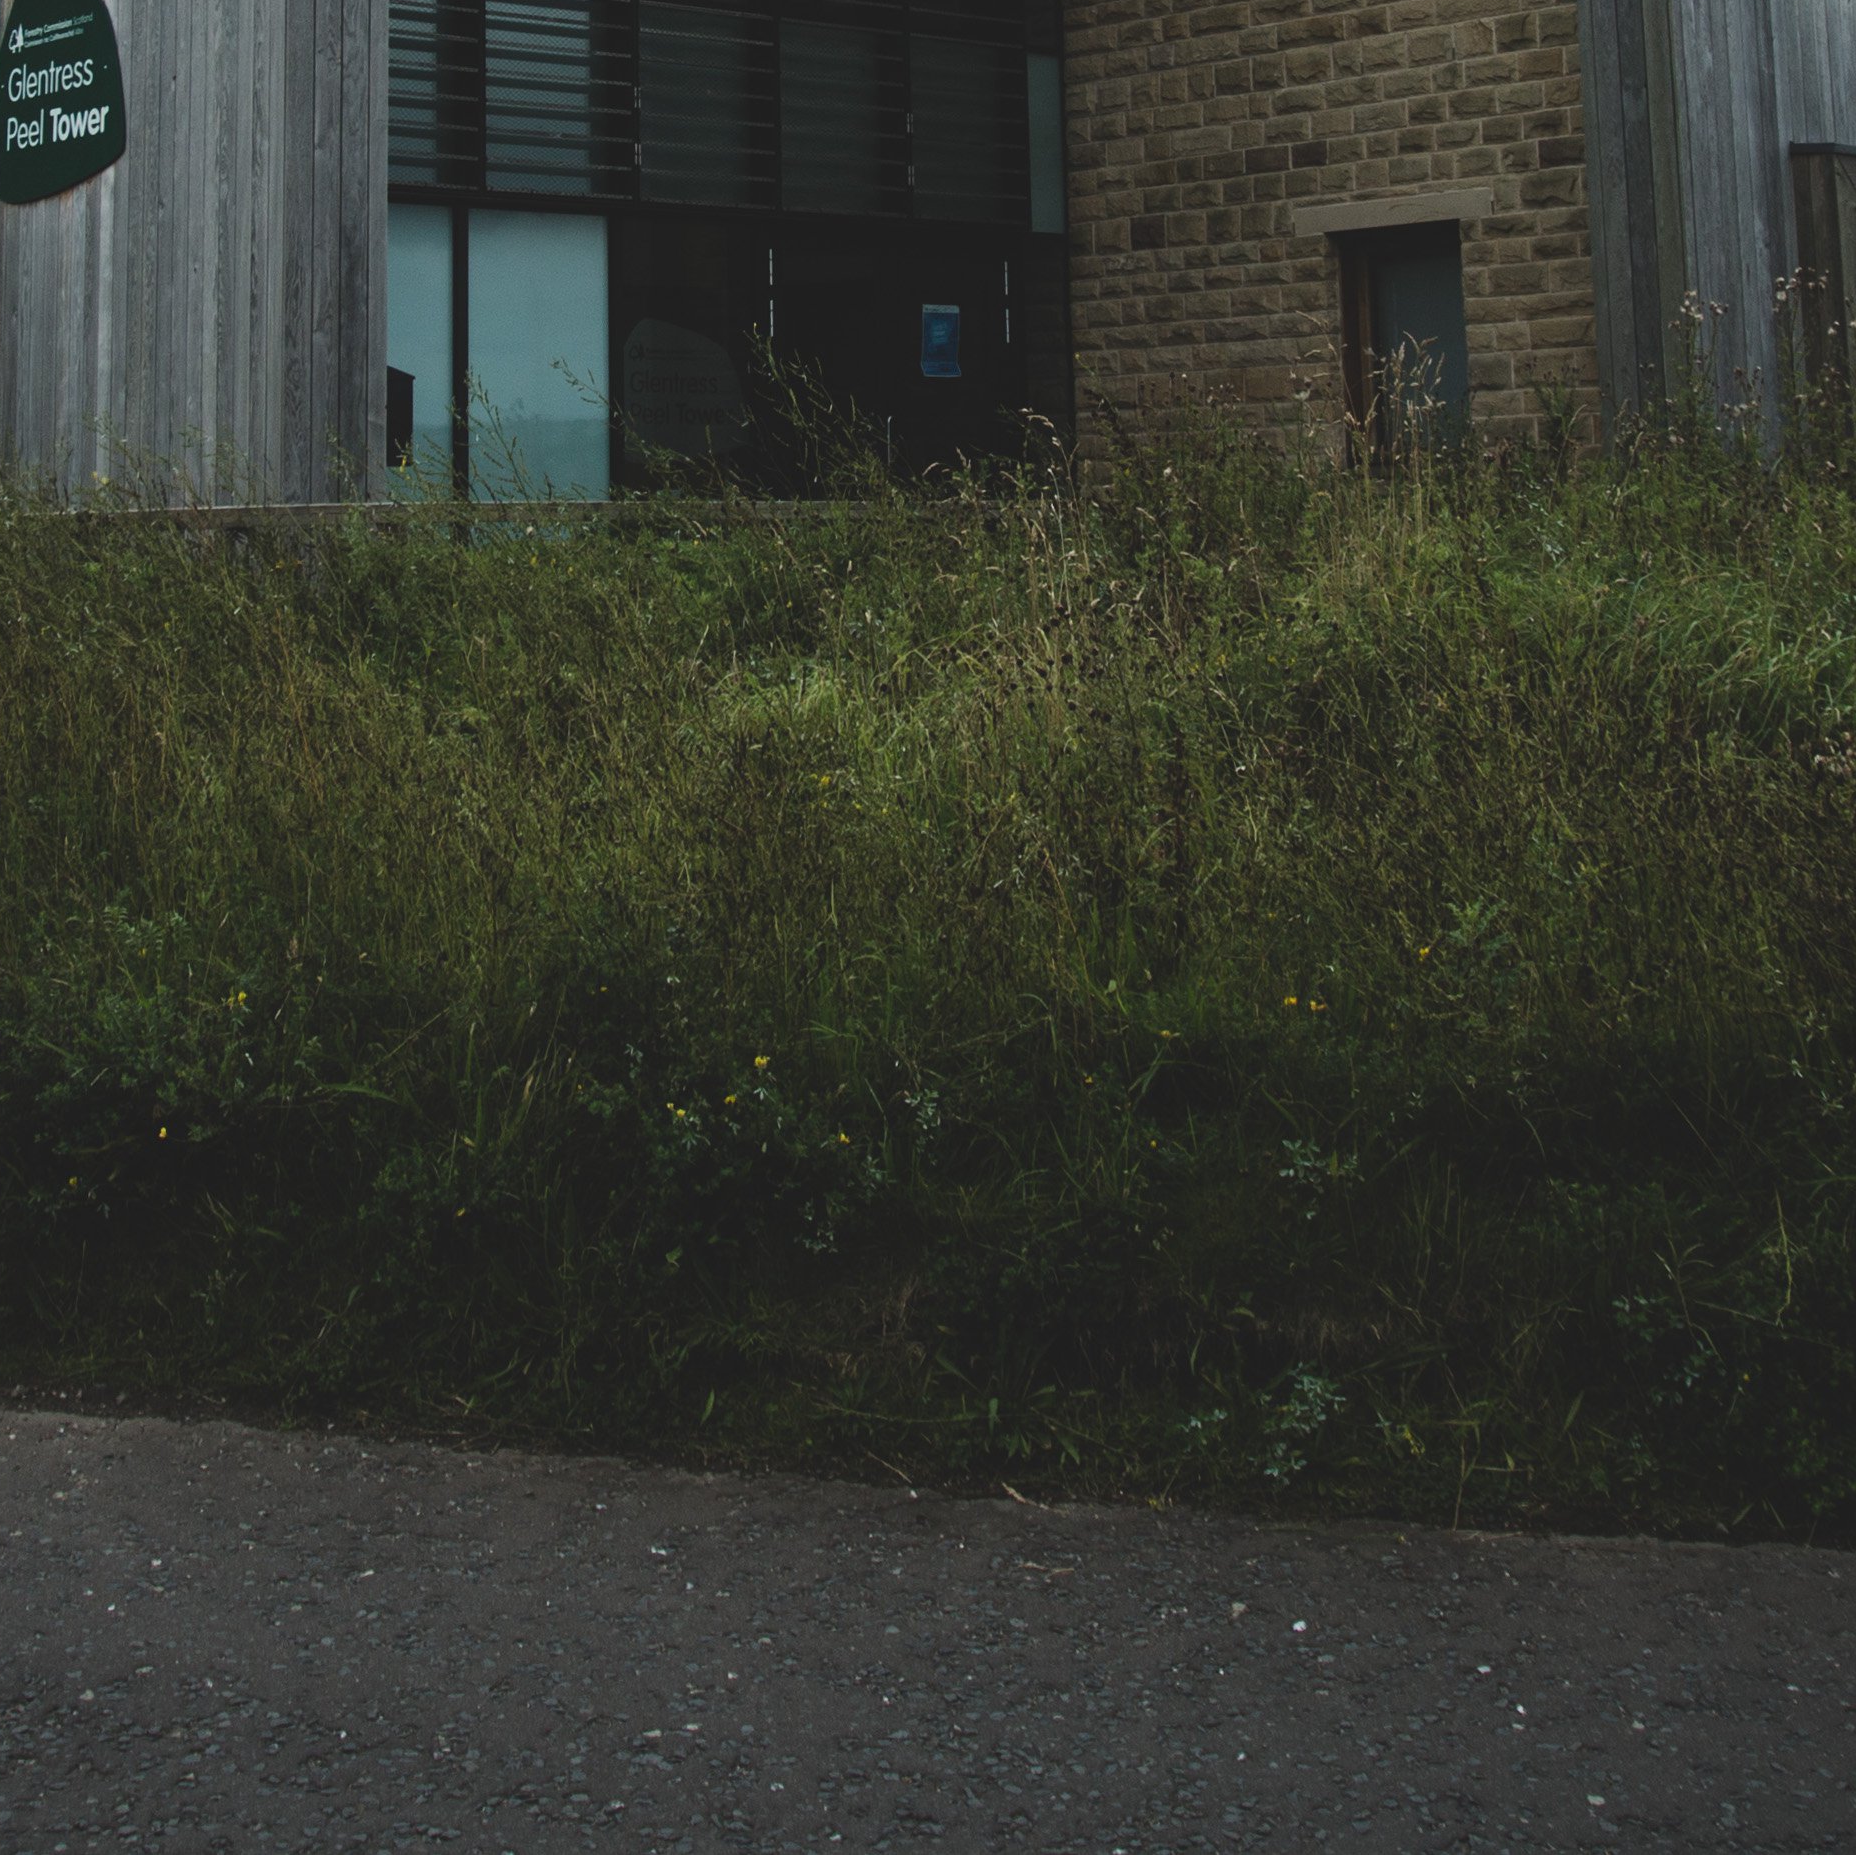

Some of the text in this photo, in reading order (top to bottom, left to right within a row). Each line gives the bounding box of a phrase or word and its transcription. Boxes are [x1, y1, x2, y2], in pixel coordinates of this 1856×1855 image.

[8, 59, 94, 102] Glentress
[6, 105, 110, 151] Peel Tower
[630, 371, 719, 394] Glentress
